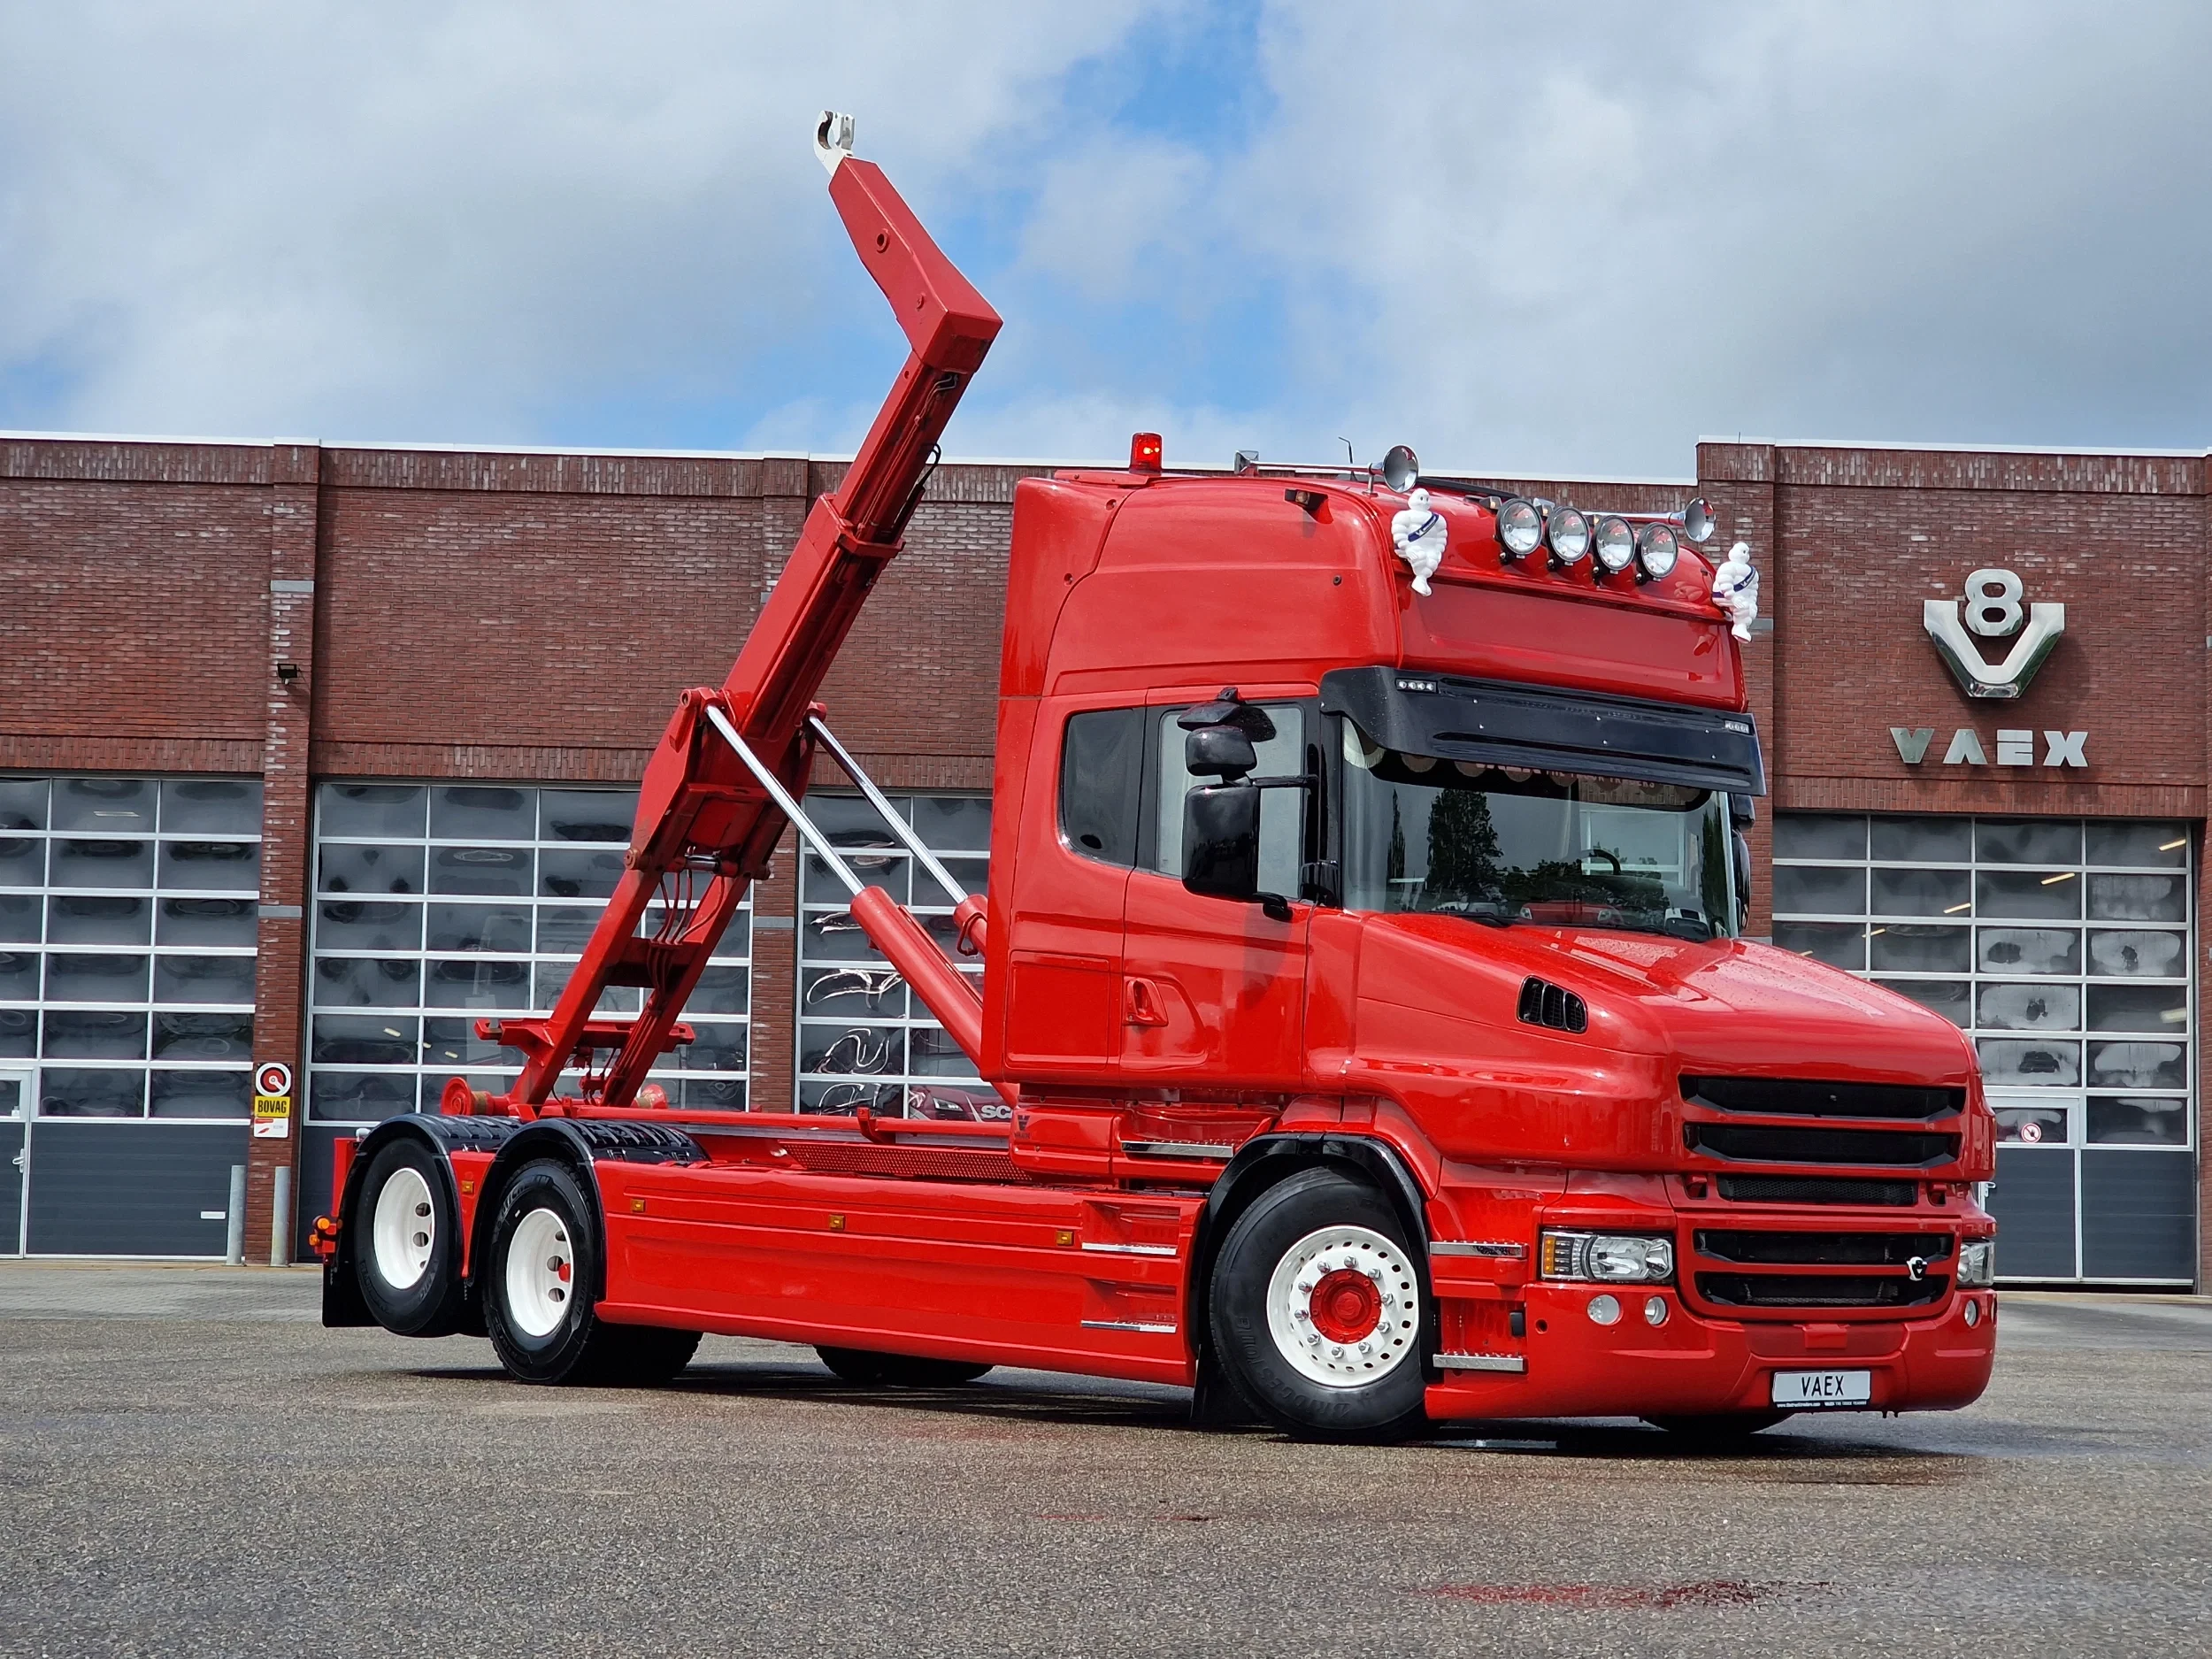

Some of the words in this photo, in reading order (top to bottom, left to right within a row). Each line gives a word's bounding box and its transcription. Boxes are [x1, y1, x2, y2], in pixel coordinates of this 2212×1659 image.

[1889, 727, 2089, 768] VAEX
[257, 1100, 288, 1113] BOVAG
[1801, 1375, 1845, 1396] VAEX
